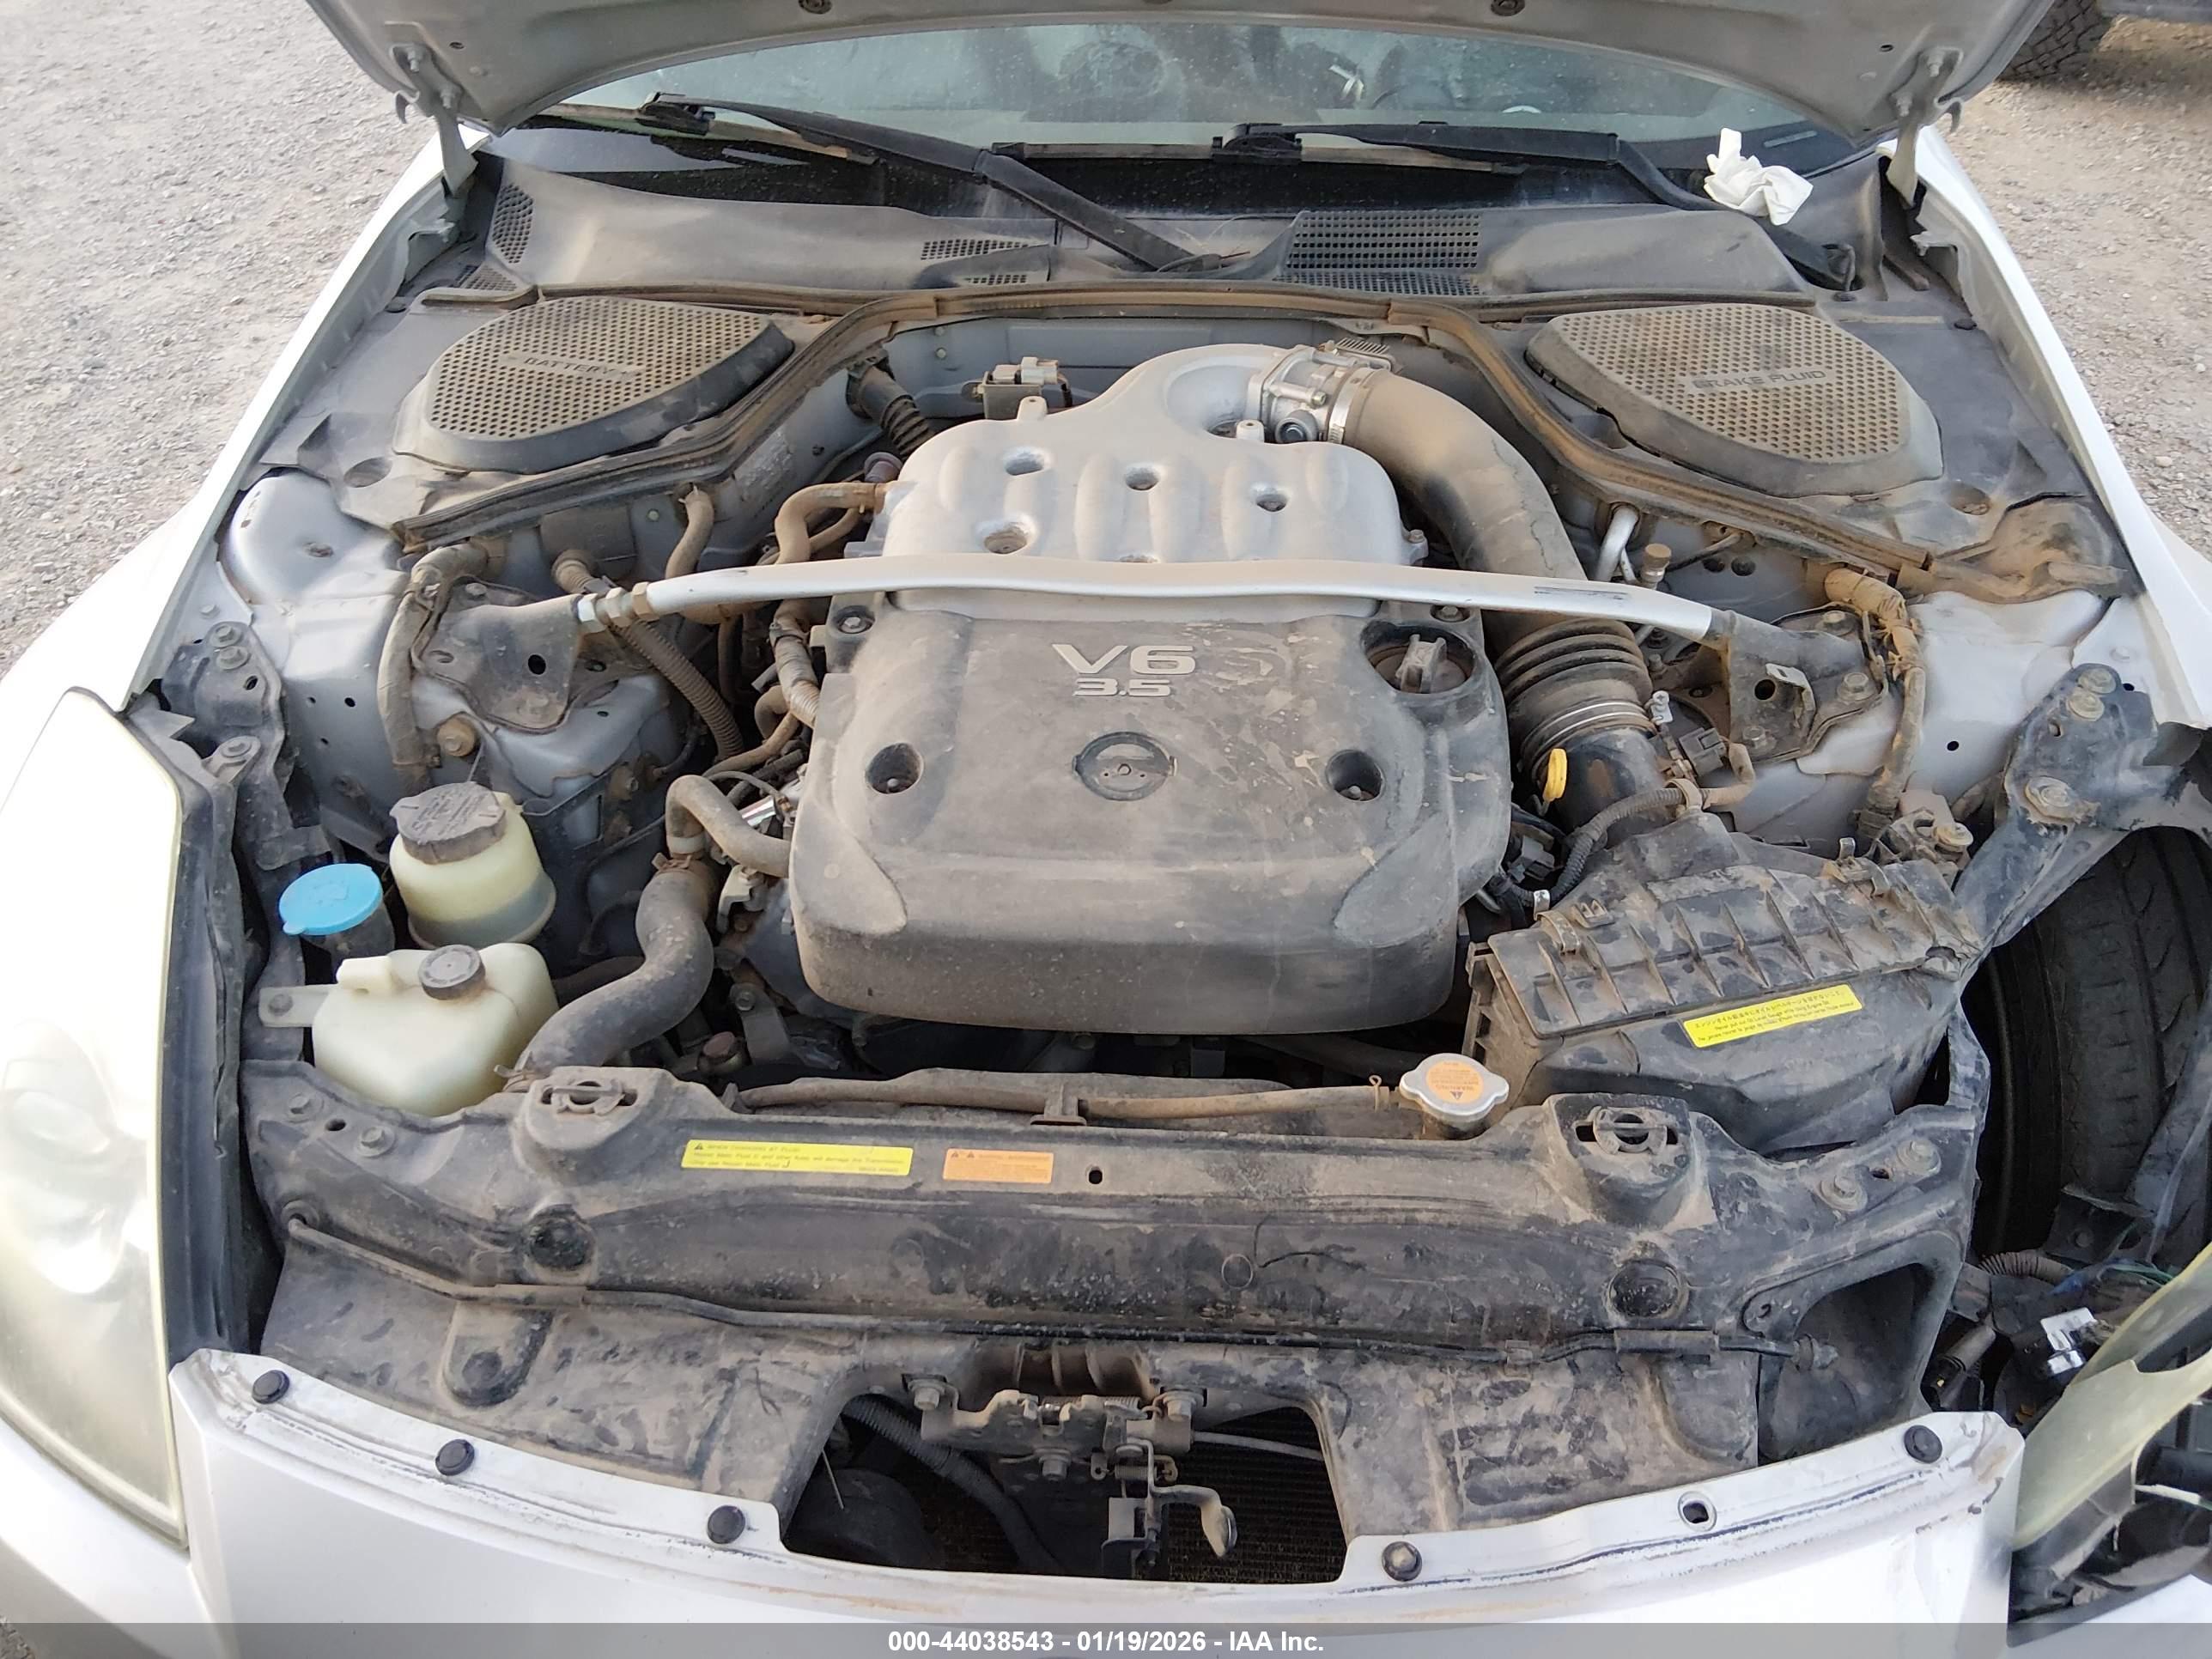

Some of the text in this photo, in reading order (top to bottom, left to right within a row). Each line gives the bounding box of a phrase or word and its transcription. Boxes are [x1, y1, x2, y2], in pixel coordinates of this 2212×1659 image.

[524, 356, 615, 374] BATTERY
[1692, 369, 1827, 389] BRAKE FLUID
[1052, 643, 1196, 675] V6
[1073, 678, 1172, 696] 3.5
